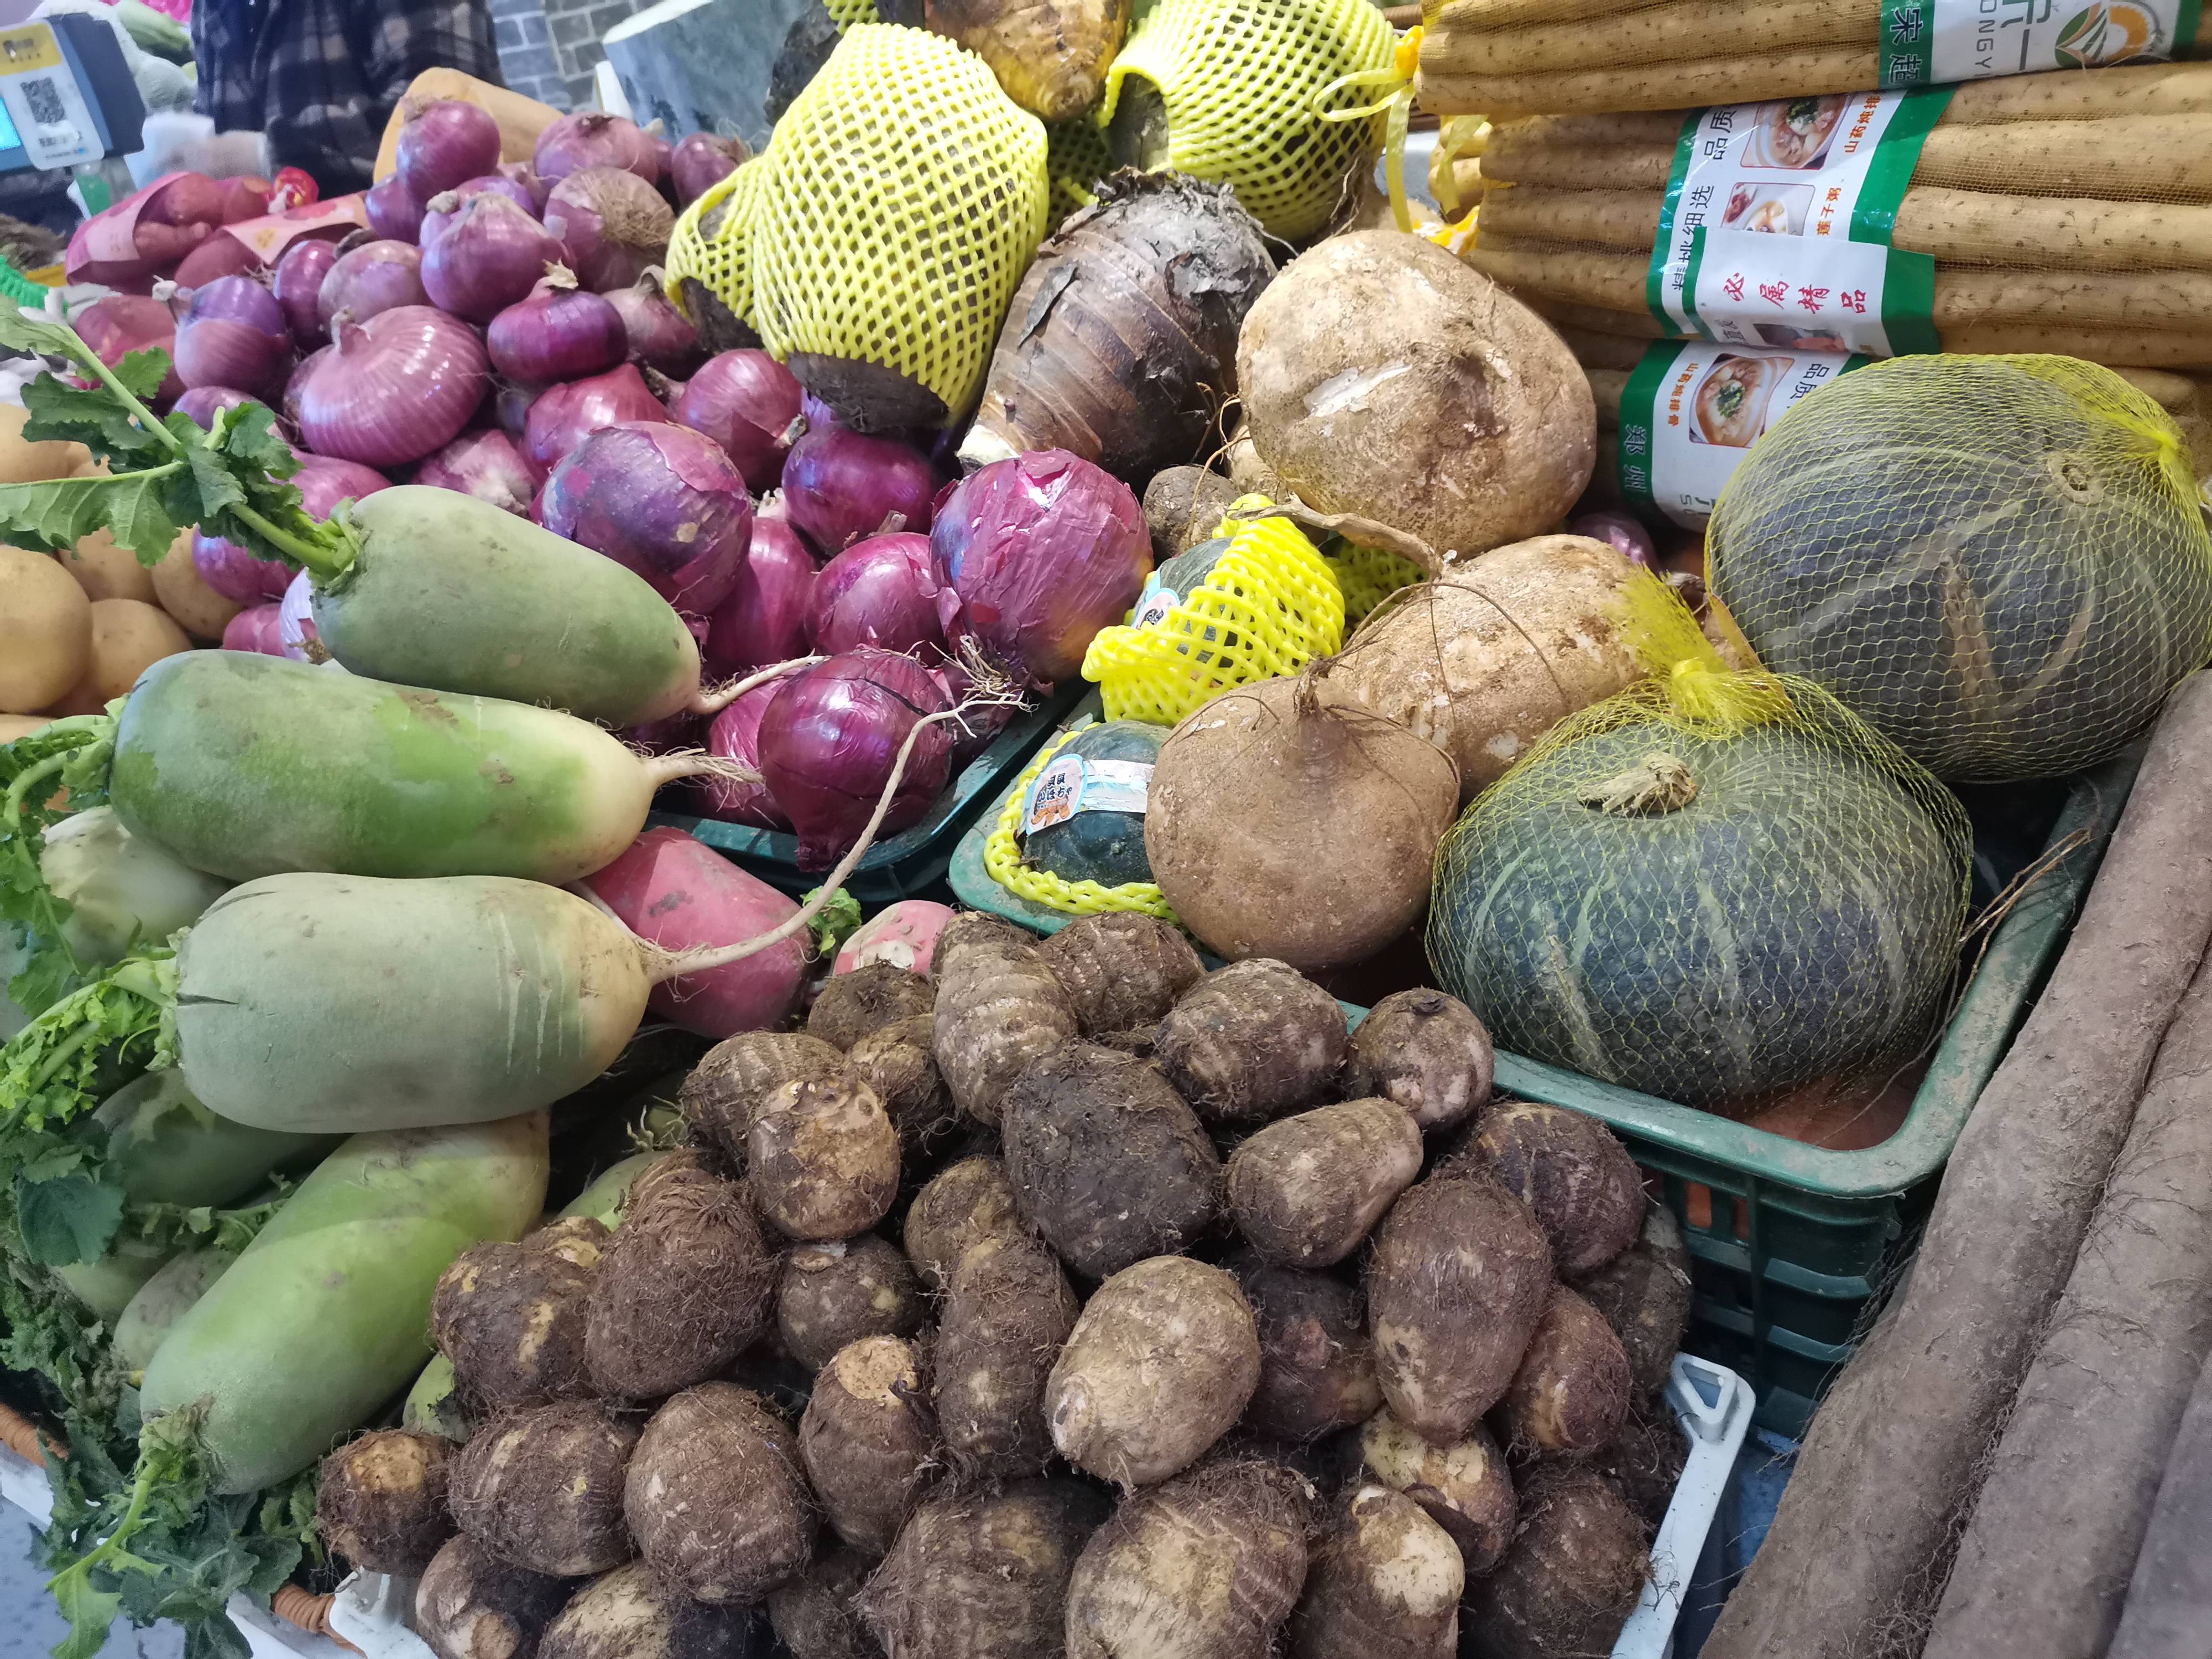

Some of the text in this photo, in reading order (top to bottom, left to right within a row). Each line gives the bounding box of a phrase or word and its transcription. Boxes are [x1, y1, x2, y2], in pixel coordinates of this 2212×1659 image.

[1889, 7, 1923, 83] 宋超
[1703, 108, 1734, 160] 品质
[1816, 187, 1842, 236] 莲子粥
[1624, 424, 1646, 492] 郑州
